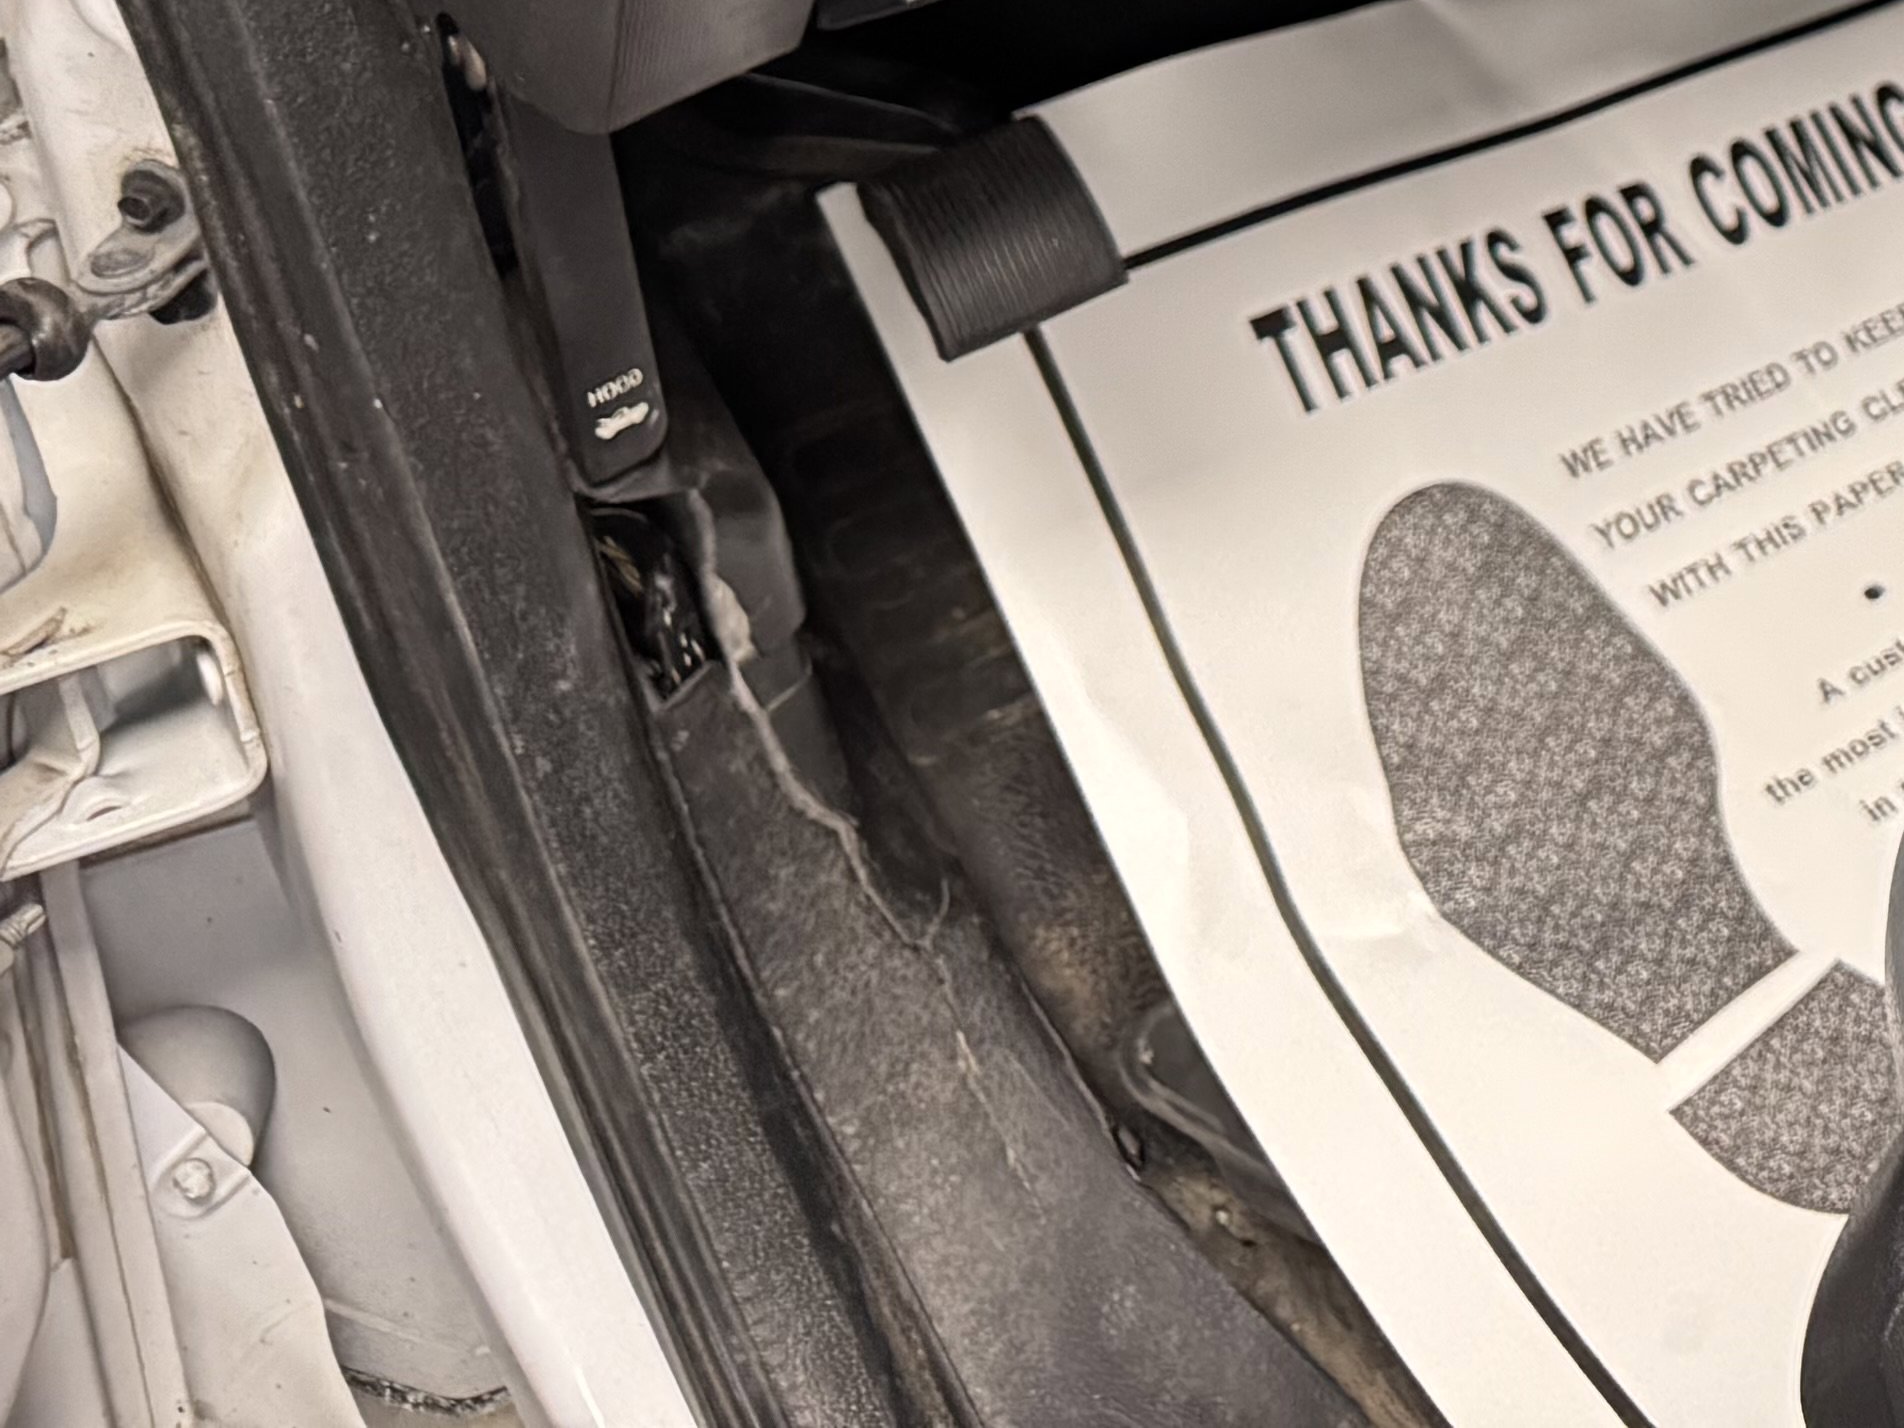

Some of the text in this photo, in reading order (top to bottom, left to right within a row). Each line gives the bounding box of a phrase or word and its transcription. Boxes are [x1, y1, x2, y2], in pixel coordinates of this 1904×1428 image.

[1247, 227, 1549, 414] THANKS
[1542, 179, 1697, 305] FOR
[586, 368, 644, 408] HOOD
[1558, 436, 1615, 479] WE
[1616, 401, 1702, 457] HAVE
[1700, 361, 1792, 422] TRIED
[1795, 340, 1839, 377] TO
[1590, 492, 1684, 550] YOUR
[1686, 409, 1857, 509] CARPETING
[1647, 555, 1732, 609] WITH
[1733, 517, 1808, 567] THIS
[1815, 677, 1845, 705] A
[1764, 768, 1818, 806] the
[1821, 717, 1898, 778] most
[1858, 794, 1897, 824] in
